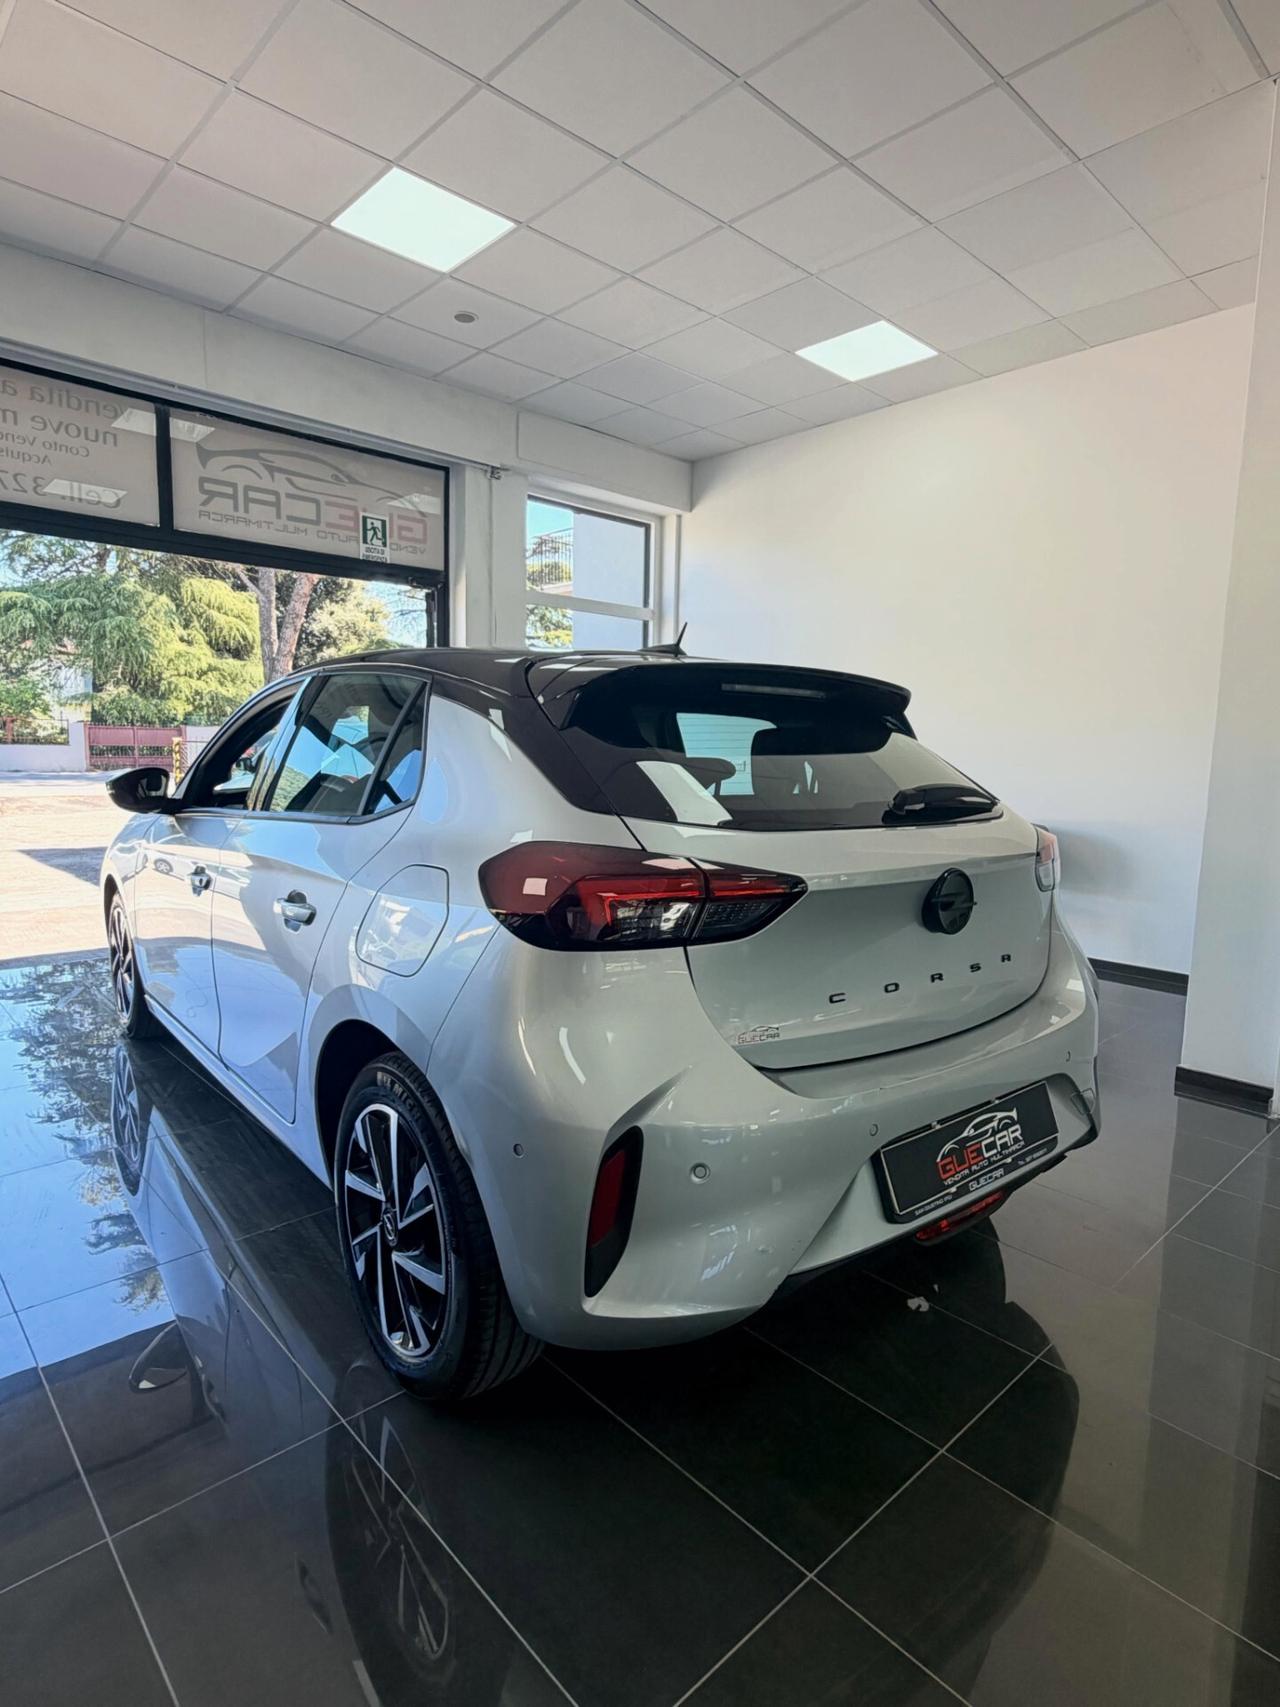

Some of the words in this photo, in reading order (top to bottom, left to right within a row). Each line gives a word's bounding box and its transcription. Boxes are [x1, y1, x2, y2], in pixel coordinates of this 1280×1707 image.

[829, 953, 1012, 1005] CORSA
[936, 1124, 1024, 1181] GUECAR
[968, 1167, 1005, 1192] GUECAR
